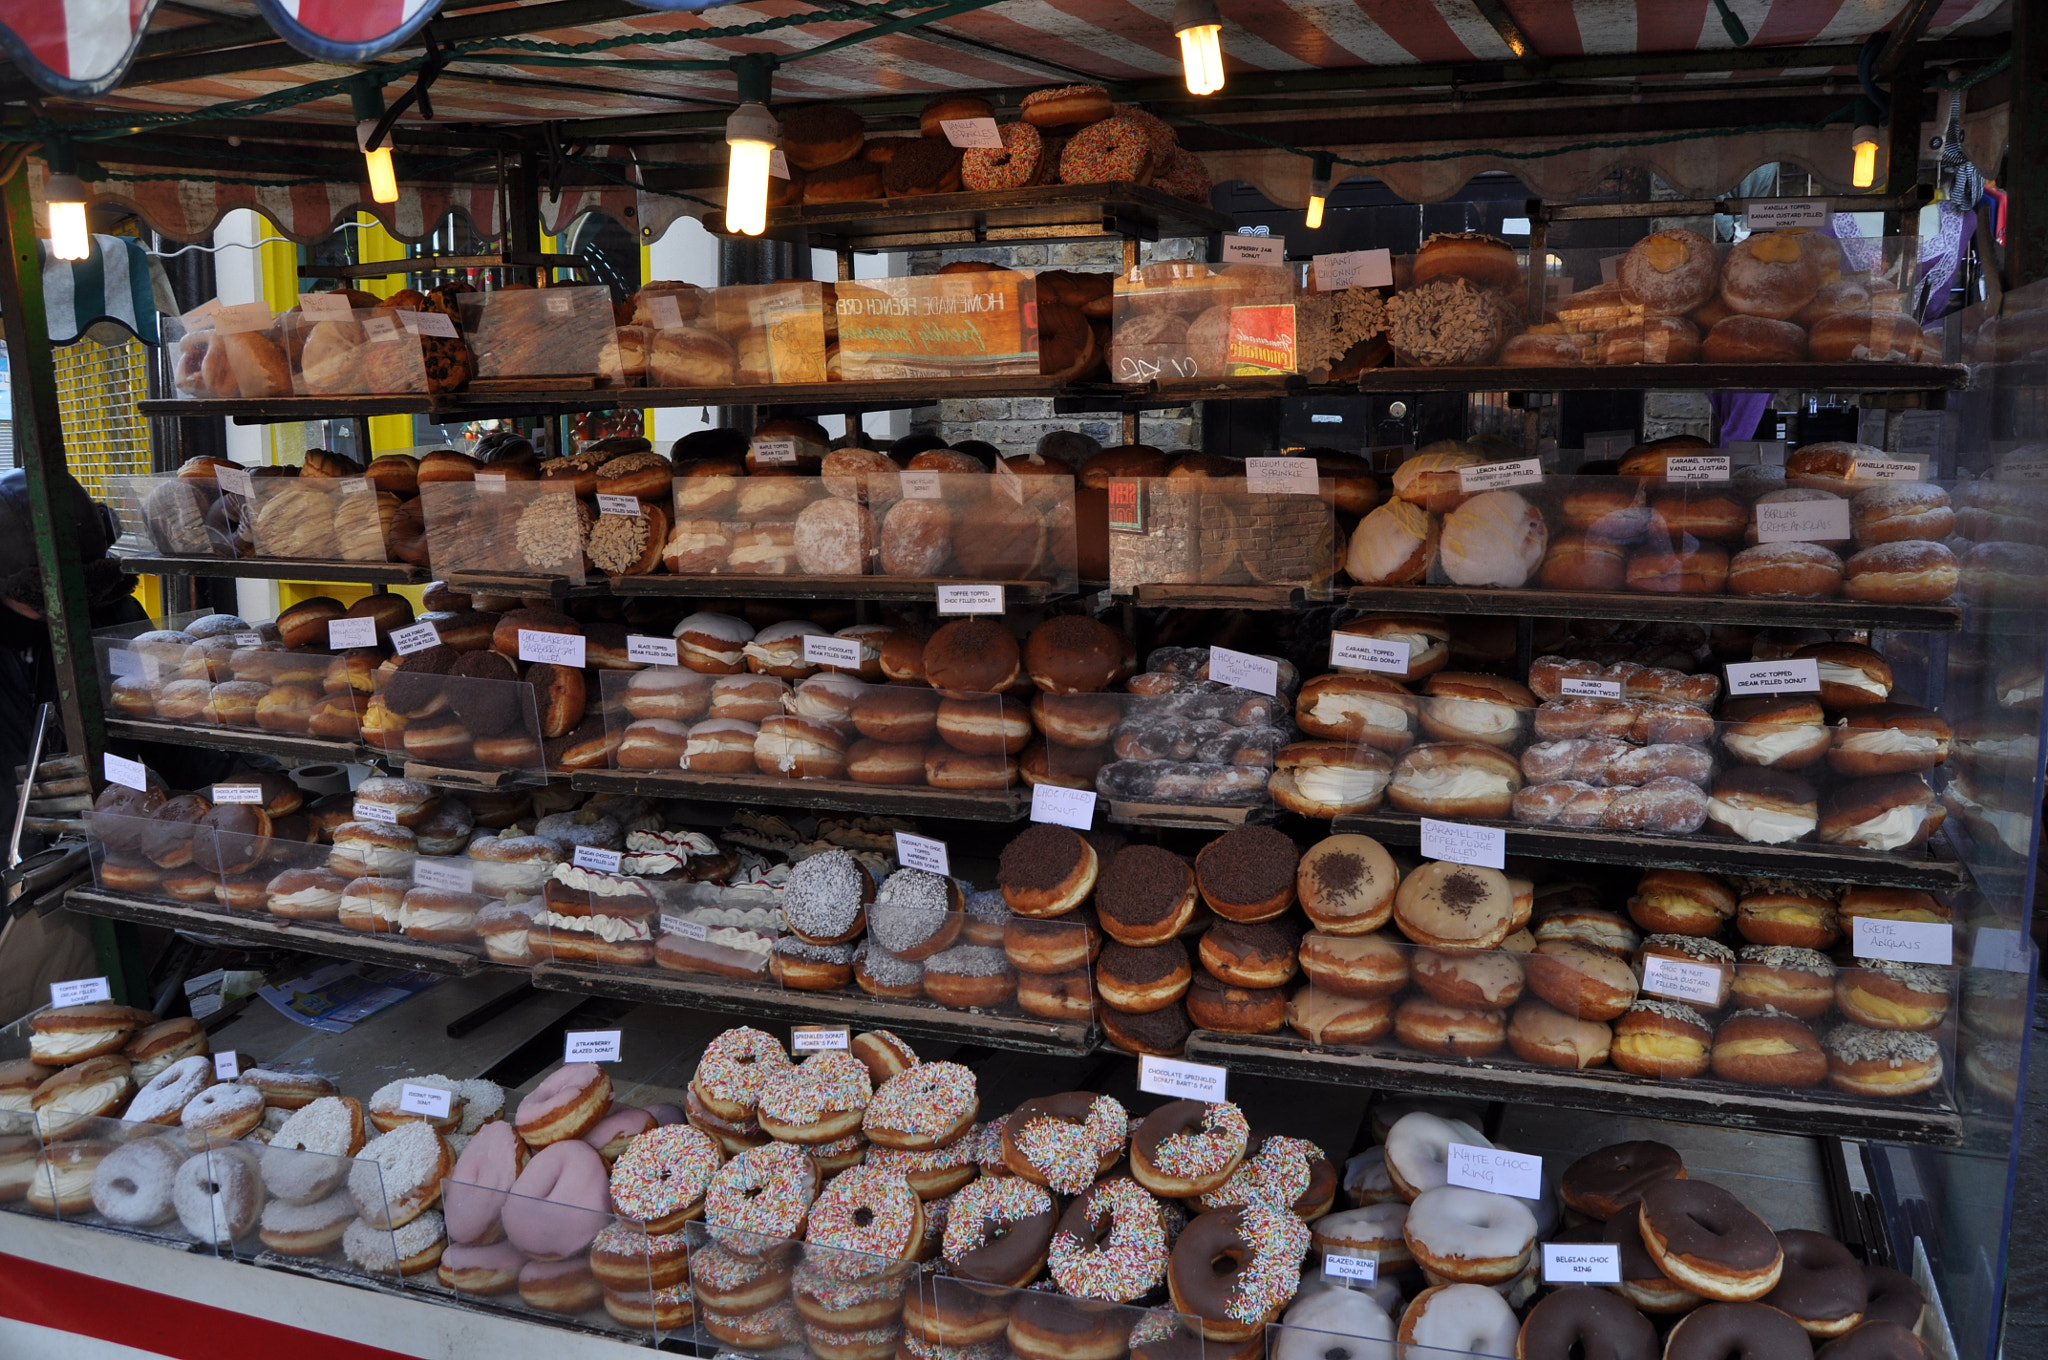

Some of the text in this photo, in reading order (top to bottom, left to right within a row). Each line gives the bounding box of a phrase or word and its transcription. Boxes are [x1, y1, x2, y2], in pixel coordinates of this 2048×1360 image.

[1776, 220, 1796, 228] DONUT
[1230, 244, 1258, 253] RASPBERRY
[1242, 252, 1261, 260] DONUT
[1250, 460, 1306, 469] BELGIUM CHOC
[1857, 462, 1916, 472] VANILLA CUSTARD
[1262, 469, 1302, 478] SPRINKLE
[1466, 474, 1498, 482] RASPBERRY
[1514, 470, 1534, 478] FILLED
[400, 628, 425, 640] BLACK FOREST
[522, 632, 538, 643] CHOC
[422, 636, 436, 645] FILLED
[828, 646, 853, 654] CHOCOLATE
[1346, 646, 1394, 657] CARAMEL TOPPED
[1212, 650, 1234, 665] CHOC
[1358, 654, 1378, 662] FILLED
[1768, 670, 1792, 678] TOPPED
[1760, 678, 1782, 686] FILLED
[1562, 688, 1597, 696] CINNAMON
[1035, 786, 1092, 804] CHOC FILLED
[1040, 800, 1077, 816] DONUT
[1425, 822, 1496, 841] CARAMEL TOP
[902, 839, 922, 848] COCONUT
[1423, 832, 1493, 851] TOFFEE FUDGE
[596, 852, 618, 860] CHOCOLATE
[914, 848, 930, 856] TOPPED
[1444, 846, 1478, 858] FILLED
[908, 859, 940, 870] FILLED DONUT
[664, 917, 703, 932] WHITE CHOCOLATE
[662, 922, 704, 939] CREAM FILLED DONUT
[1870, 936, 1921, 950] ANGLAIS
[1660, 964, 1704, 978] CHOC NUT
[1650, 972, 1710, 987] VANILLA CUSTARD
[80, 982, 99, 990] TOPPED
[1656, 980, 1702, 994] FILLED DONUT
[78, 988, 98, 996] FILLED
[1148, 1068, 1217, 1085] CHOCOLATE SPRINKLED
[1153, 1076, 1198, 1089] DONUT BART'S
[1453, 1146, 1531, 1172] WHITE CHOC
[1462, 1164, 1494, 1186] RING
[1328, 1256, 1374, 1268] GLAZED RING
[1556, 1256, 1609, 1264] BELGIAN CHOC
[1339, 1267, 1364, 1276] DONUT
